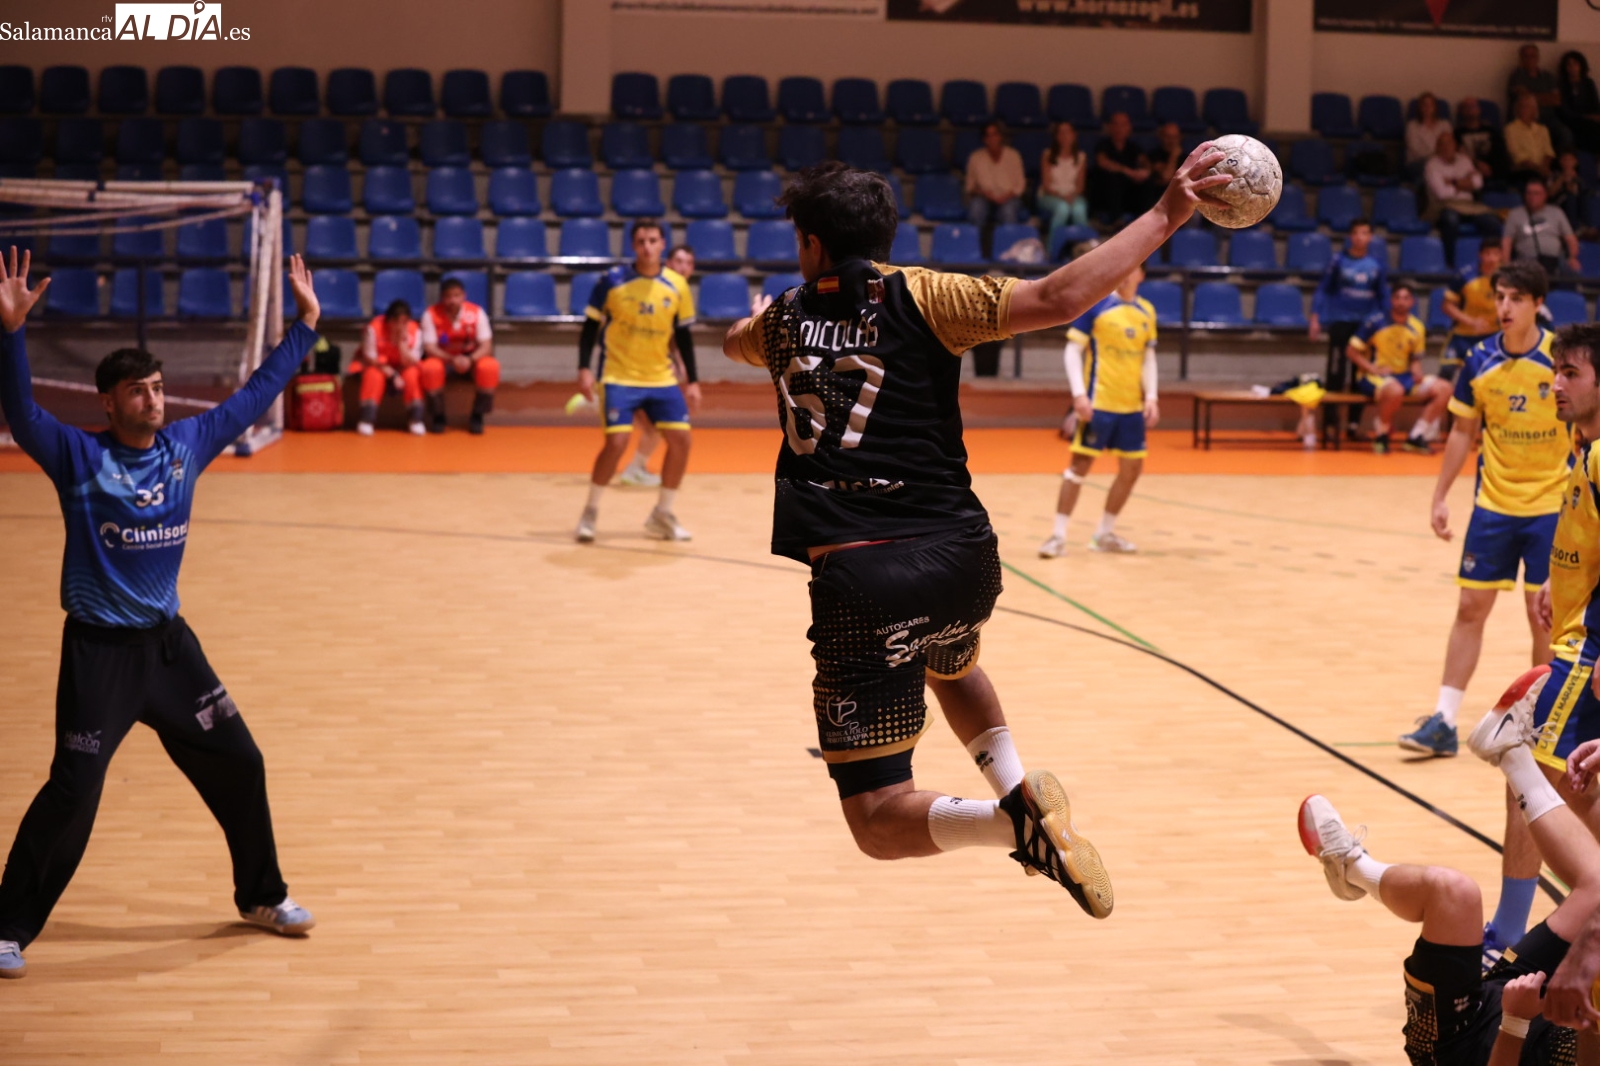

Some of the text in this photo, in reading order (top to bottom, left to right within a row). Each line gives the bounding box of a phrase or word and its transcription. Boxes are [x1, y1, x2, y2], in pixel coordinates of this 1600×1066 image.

[800, 308, 879, 352] NICOLÁS
[778, 354, 885, 456] 67
[876, 616, 930, 636] AUTOCARES
